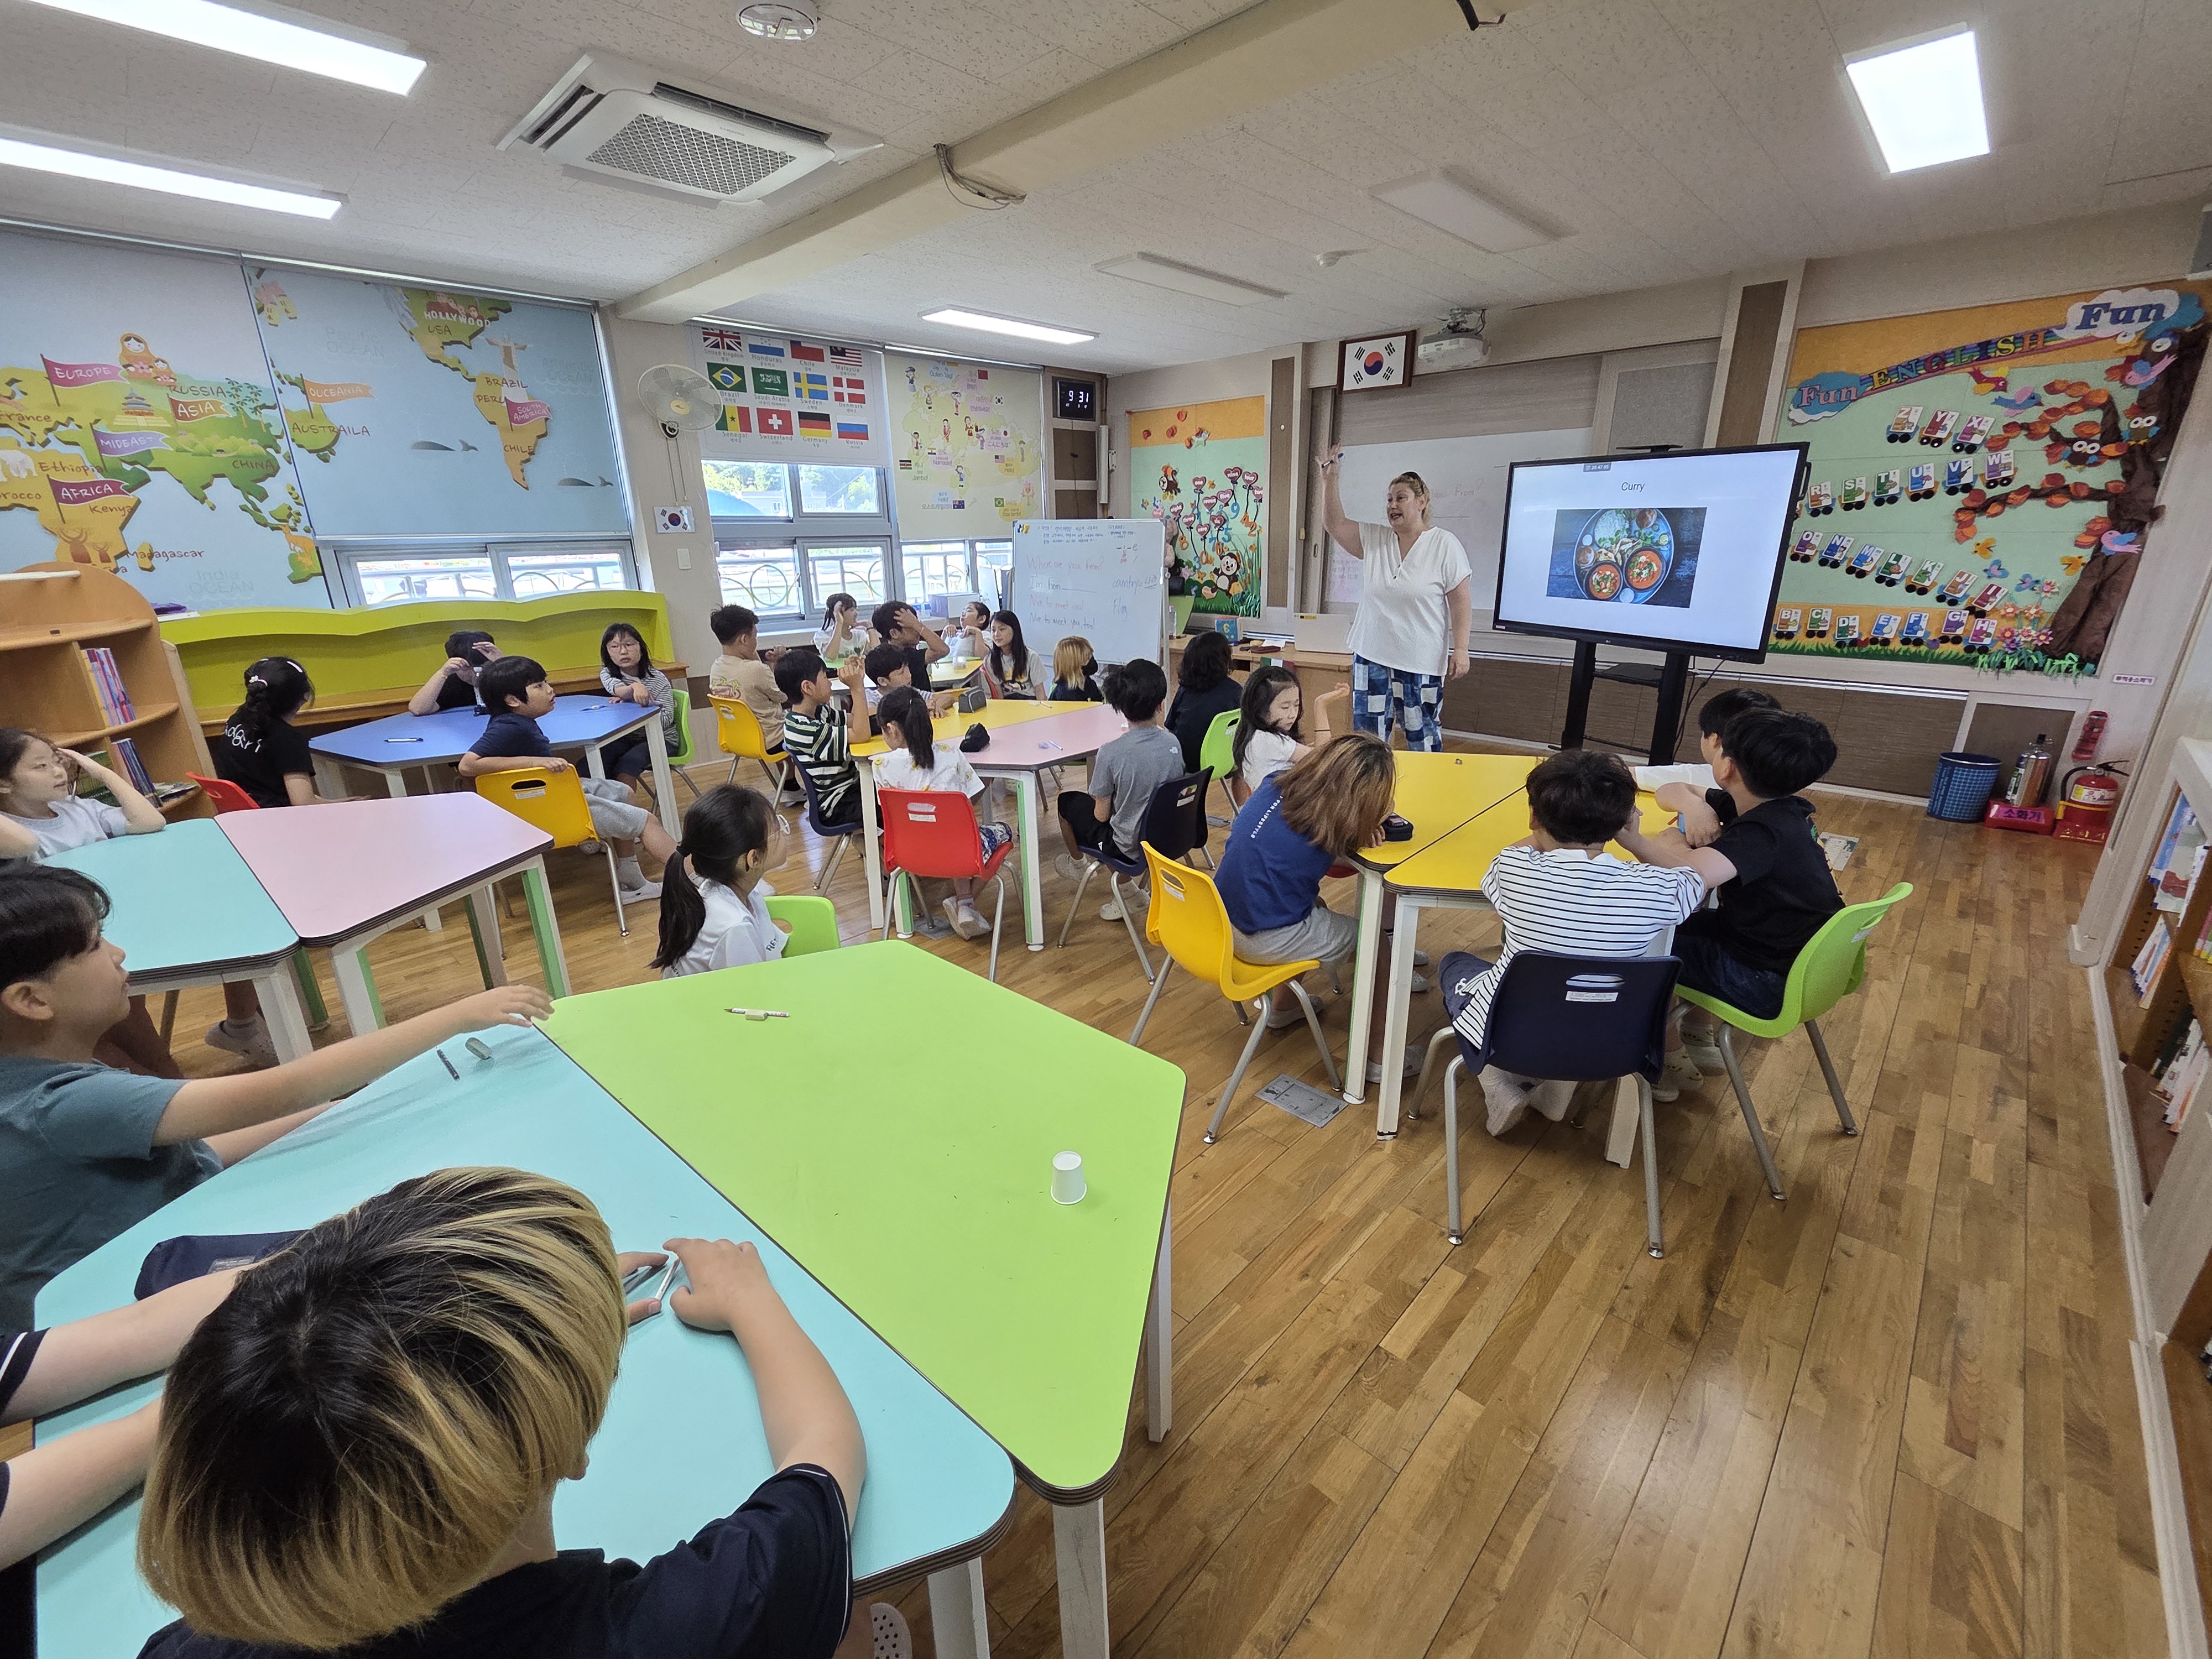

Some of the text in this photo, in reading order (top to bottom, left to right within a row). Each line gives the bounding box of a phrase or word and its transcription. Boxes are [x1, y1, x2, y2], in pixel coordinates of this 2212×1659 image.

[425, 311, 491, 326] HOLLYWOOD
[2075, 302, 2166, 330] Fun
[428, 325, 452, 335] USA
[752, 354, 782, 363] Honduras
[1871, 332, 2046, 390] ENGLISH
[54, 367, 112, 379] EUROPE
[836, 364, 860, 373] Malaysia
[485, 377, 529, 388] BRAZIL
[169, 385, 227, 398] RUSSIA
[309, 387, 363, 398] OUCEANIA
[1798, 384, 1859, 407] Fun
[476, 395, 505, 404] PERU
[178, 402, 215, 418] ASIA
[517, 404, 541, 414] SOUTH
[1897, 408, 1911, 418] Z
[514, 409, 547, 421] AMERICA
[1936, 411, 1949, 422] Y
[1967, 416, 1983, 427] X
[292, 422, 371, 436] AUSTRAILA
[504, 445, 535, 453] CHILE
[1987, 453, 2001, 465] W
[39, 461, 105, 476] Ethiopia
[232, 460, 275, 470] CHINA
[1948, 461, 1960, 472] V
[1878, 472, 1888, 483] T
[1912, 467, 1923, 477] U
[1621, 482, 1645, 492] Curry
[1845, 480, 1855, 489] S
[61, 483, 113, 499] AFRICA
[1811, 486, 1821, 495] R
[89, 503, 133, 517] Kenya
[1230, 502, 1240, 519] 9
[1222, 526, 1232, 542] 5
[1802, 531, 1813, 541] O
[1832, 535, 1845, 545] N
[125, 549, 205, 561] Madagascar
[1861, 545, 1876, 556] M
[1888, 554, 1897, 564] L
[1922, 561, 1936, 571] K
[1955, 573, 1967, 582] J
[189, 580, 254, 594] OCEAN
[1781, 609, 1792, 619] B
[1812, 609, 1822, 618] C
[1910, 614, 1920, 623] F
[1948, 612, 1960, 622] G
[1839, 618, 1849, 627] D
[1879, 615, 1890, 625] E
[1976, 620, 1990, 630] H
[1251, 799, 1280, 838] FOR LIFESTYLE
[2003, 809, 2042, 821] 소화기
